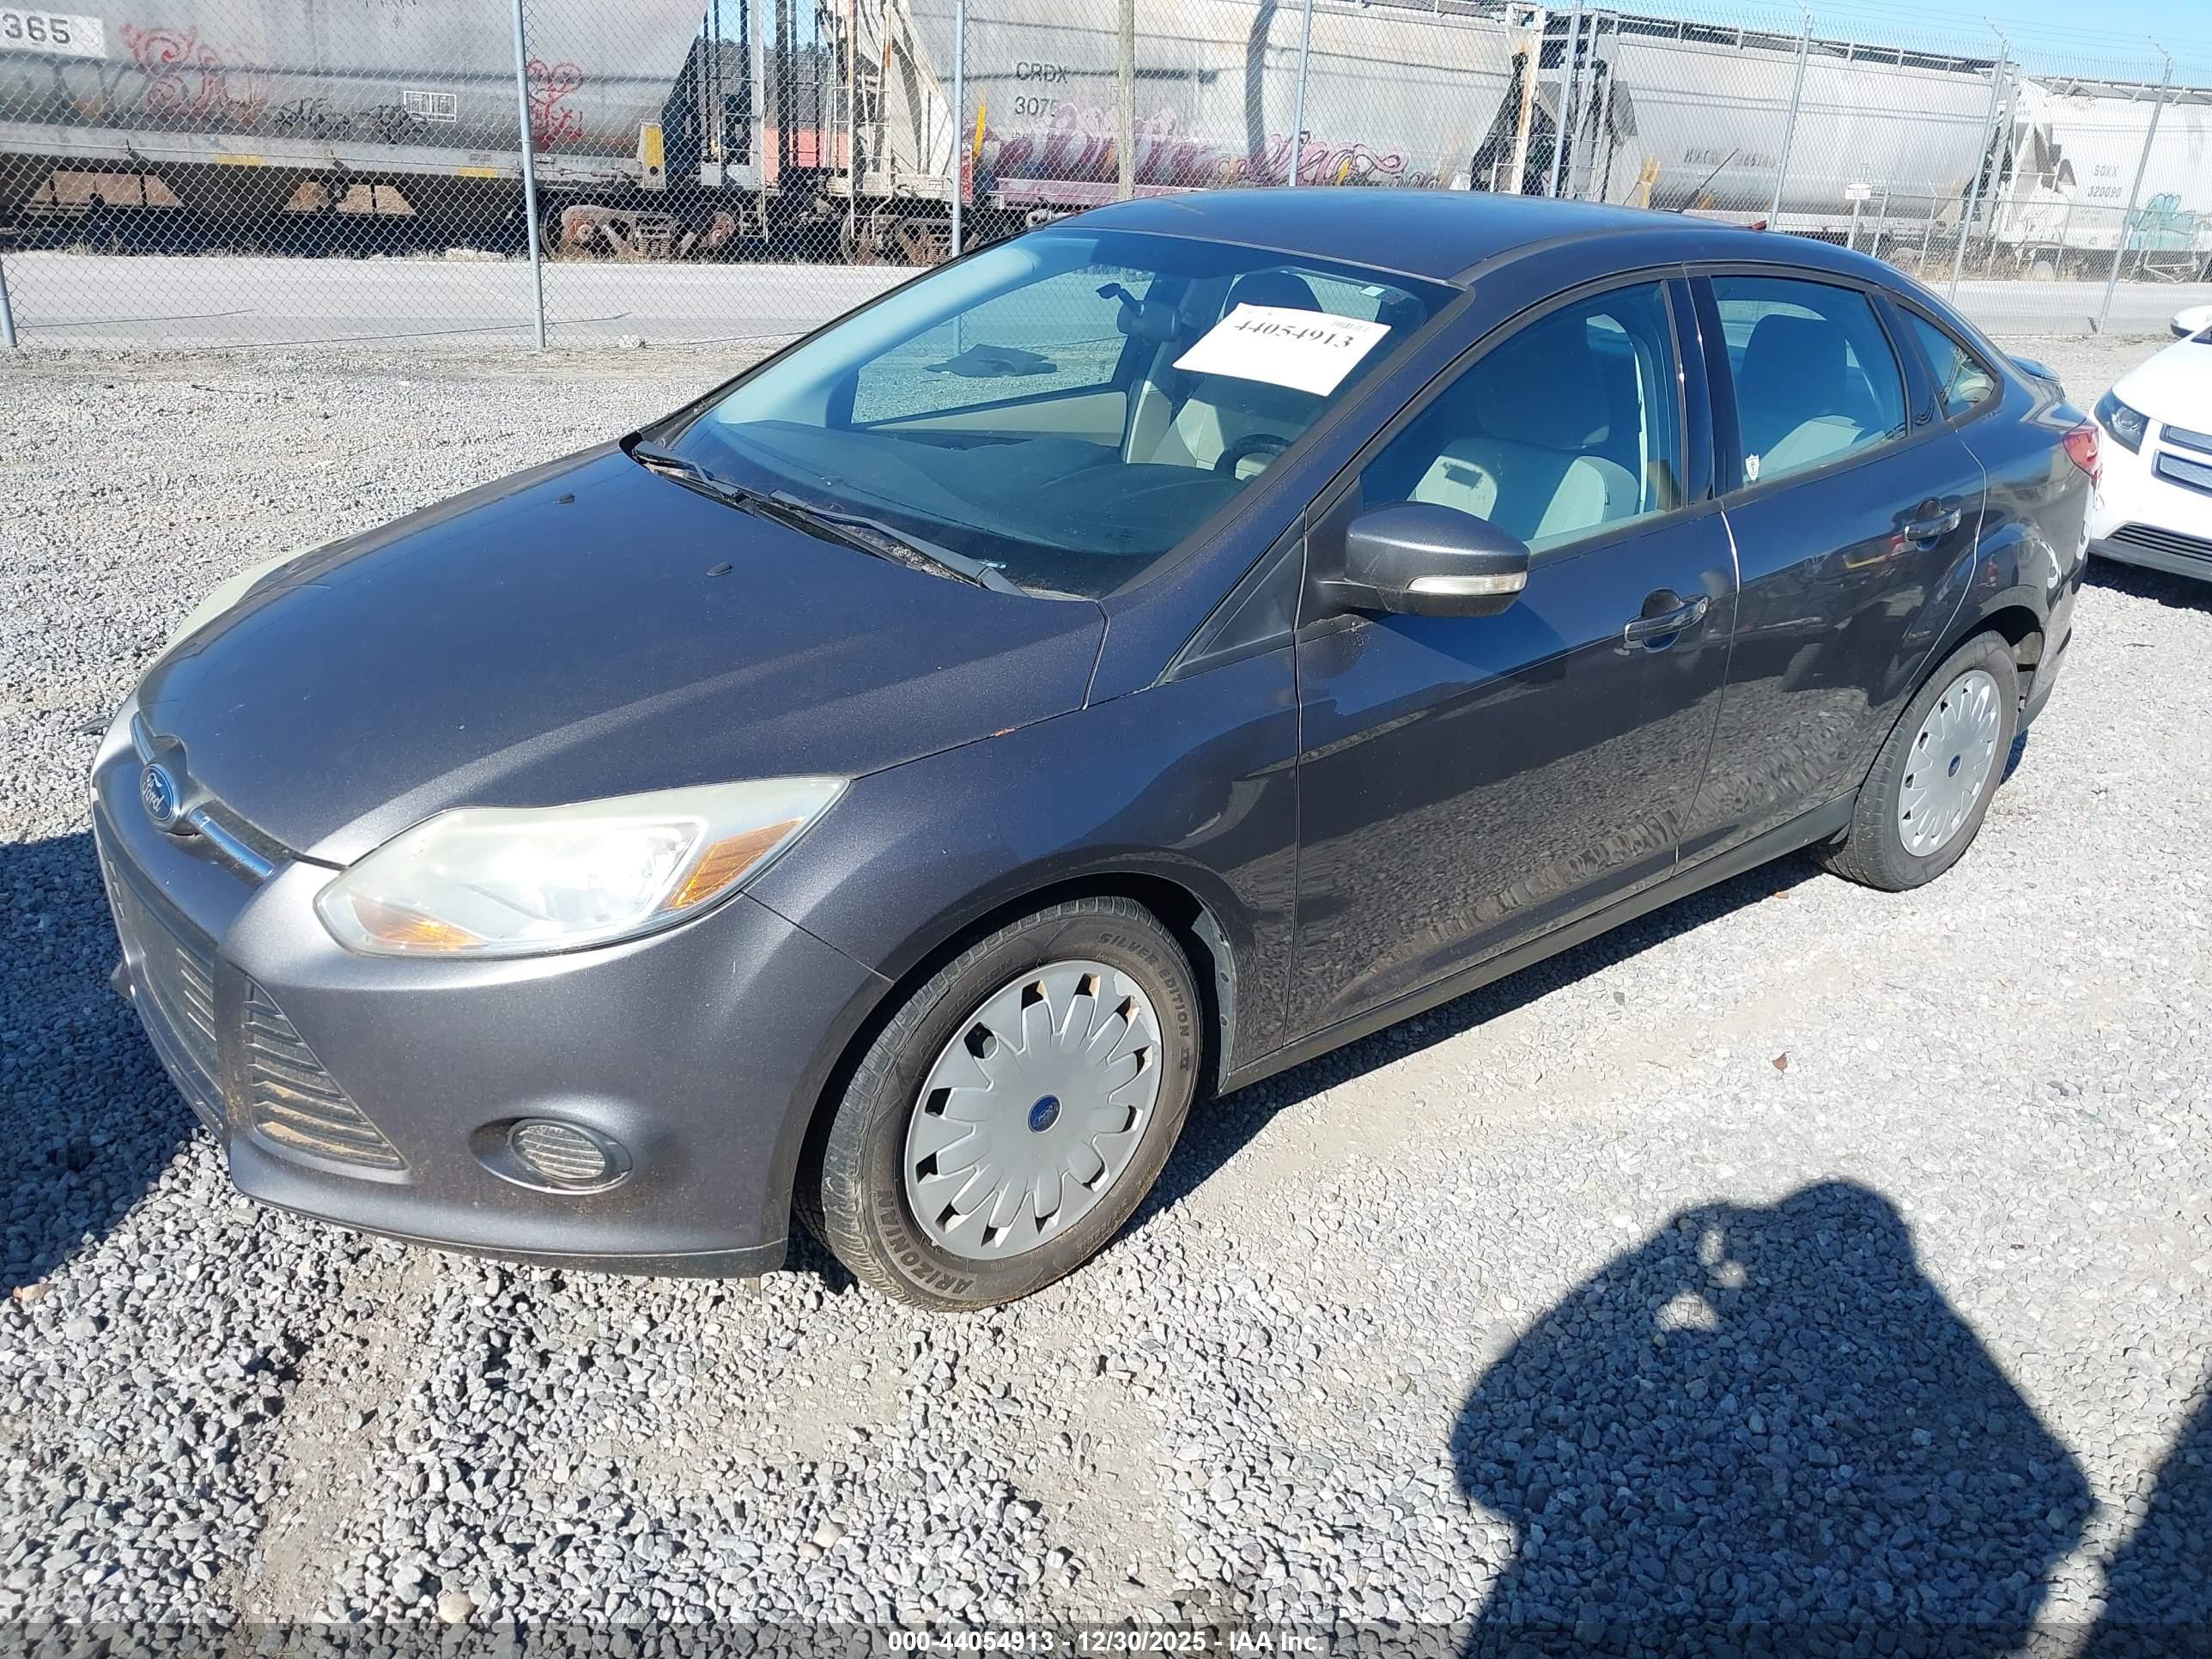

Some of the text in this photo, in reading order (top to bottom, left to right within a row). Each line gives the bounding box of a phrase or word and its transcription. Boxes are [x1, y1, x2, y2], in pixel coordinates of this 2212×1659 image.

[3, 13, 71, 45] 365
[1016, 61, 1068, 83] CRDX
[1234, 319, 1355, 349] 44054913
[142, 772, 166, 812] Ford
[1159, 969, 1190, 1037] EDITION
[878, 1190, 974, 1294] ARIZONIAN
